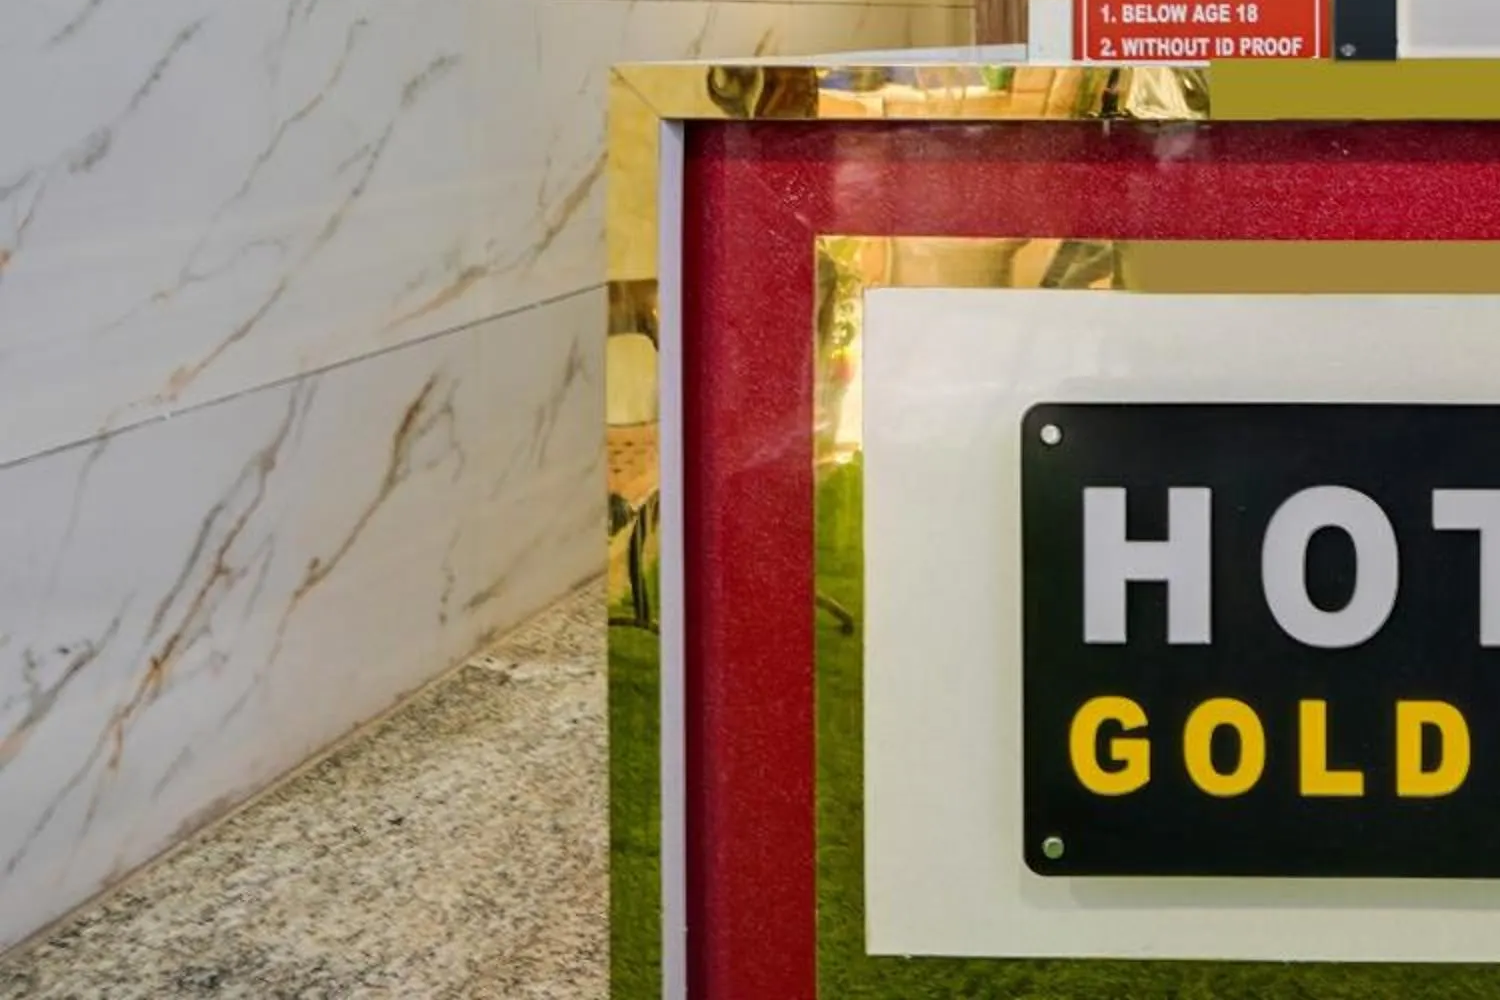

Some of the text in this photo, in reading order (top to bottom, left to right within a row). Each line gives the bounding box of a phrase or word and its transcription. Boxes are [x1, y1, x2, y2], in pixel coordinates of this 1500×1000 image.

[1100, 4, 1258, 23] 1. BELOW AGE 18
[1100, 37, 1303, 57] 2. WITHOUT ID PROOF
[1069, 696, 1470, 797] GOLD
